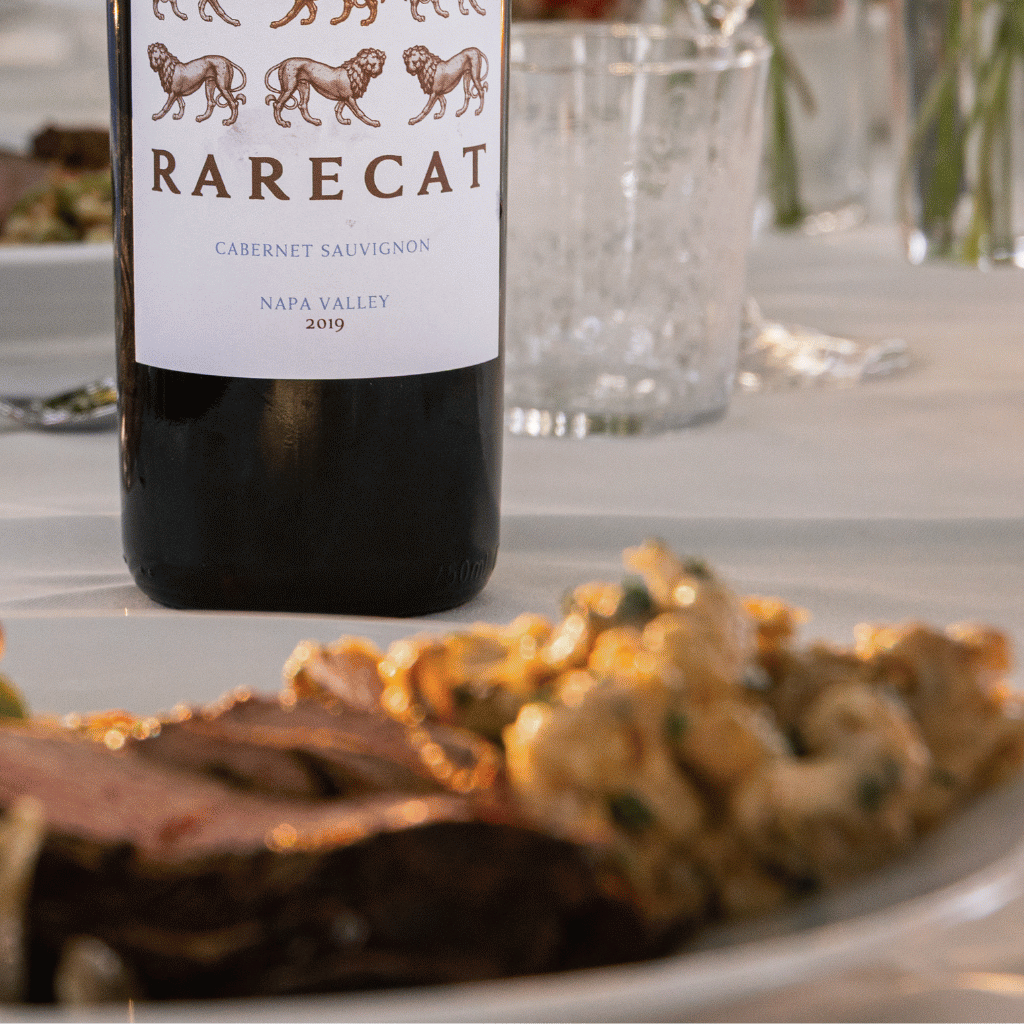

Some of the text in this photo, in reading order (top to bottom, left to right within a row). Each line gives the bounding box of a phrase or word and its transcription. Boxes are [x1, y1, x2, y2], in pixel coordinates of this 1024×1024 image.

[151, 143, 487, 201] RARECAT
[215, 238, 430, 258] CABERNET SAUVIGNON
[260, 294, 390, 311] NAPA VALLEY
[305, 318, 345, 333] 2019
